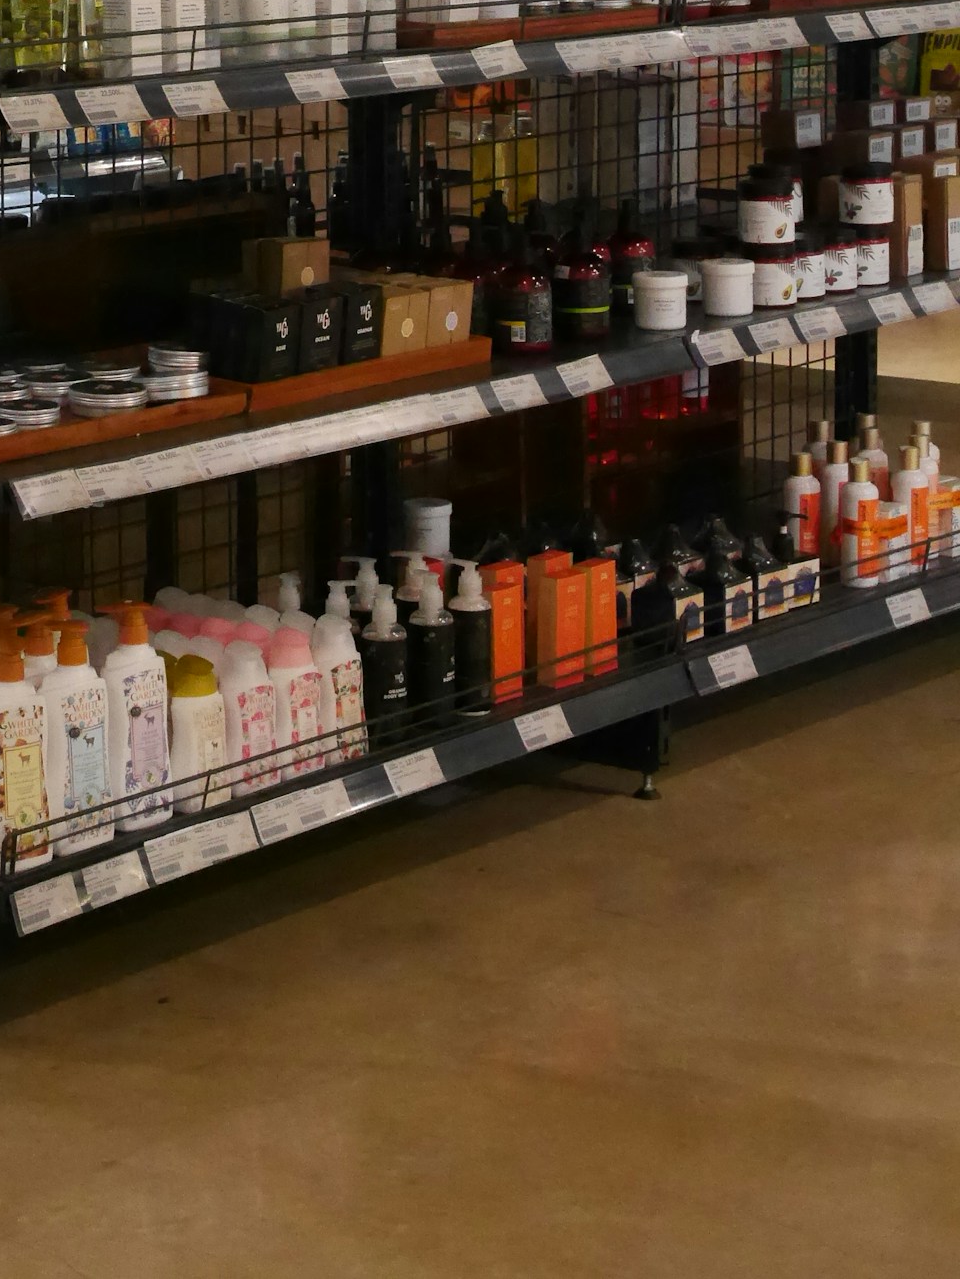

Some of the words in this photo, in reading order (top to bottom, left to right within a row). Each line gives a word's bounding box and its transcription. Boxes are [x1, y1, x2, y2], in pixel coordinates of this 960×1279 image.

[132, 680, 159, 692] WHITE
[130, 687, 164, 702] GARDEN
[72, 701, 99, 713] WHITE
[68, 709, 104, 723] GARDEN
[7, 719, 35, 731] WHITE
[4, 727, 40, 740] GARDEN
